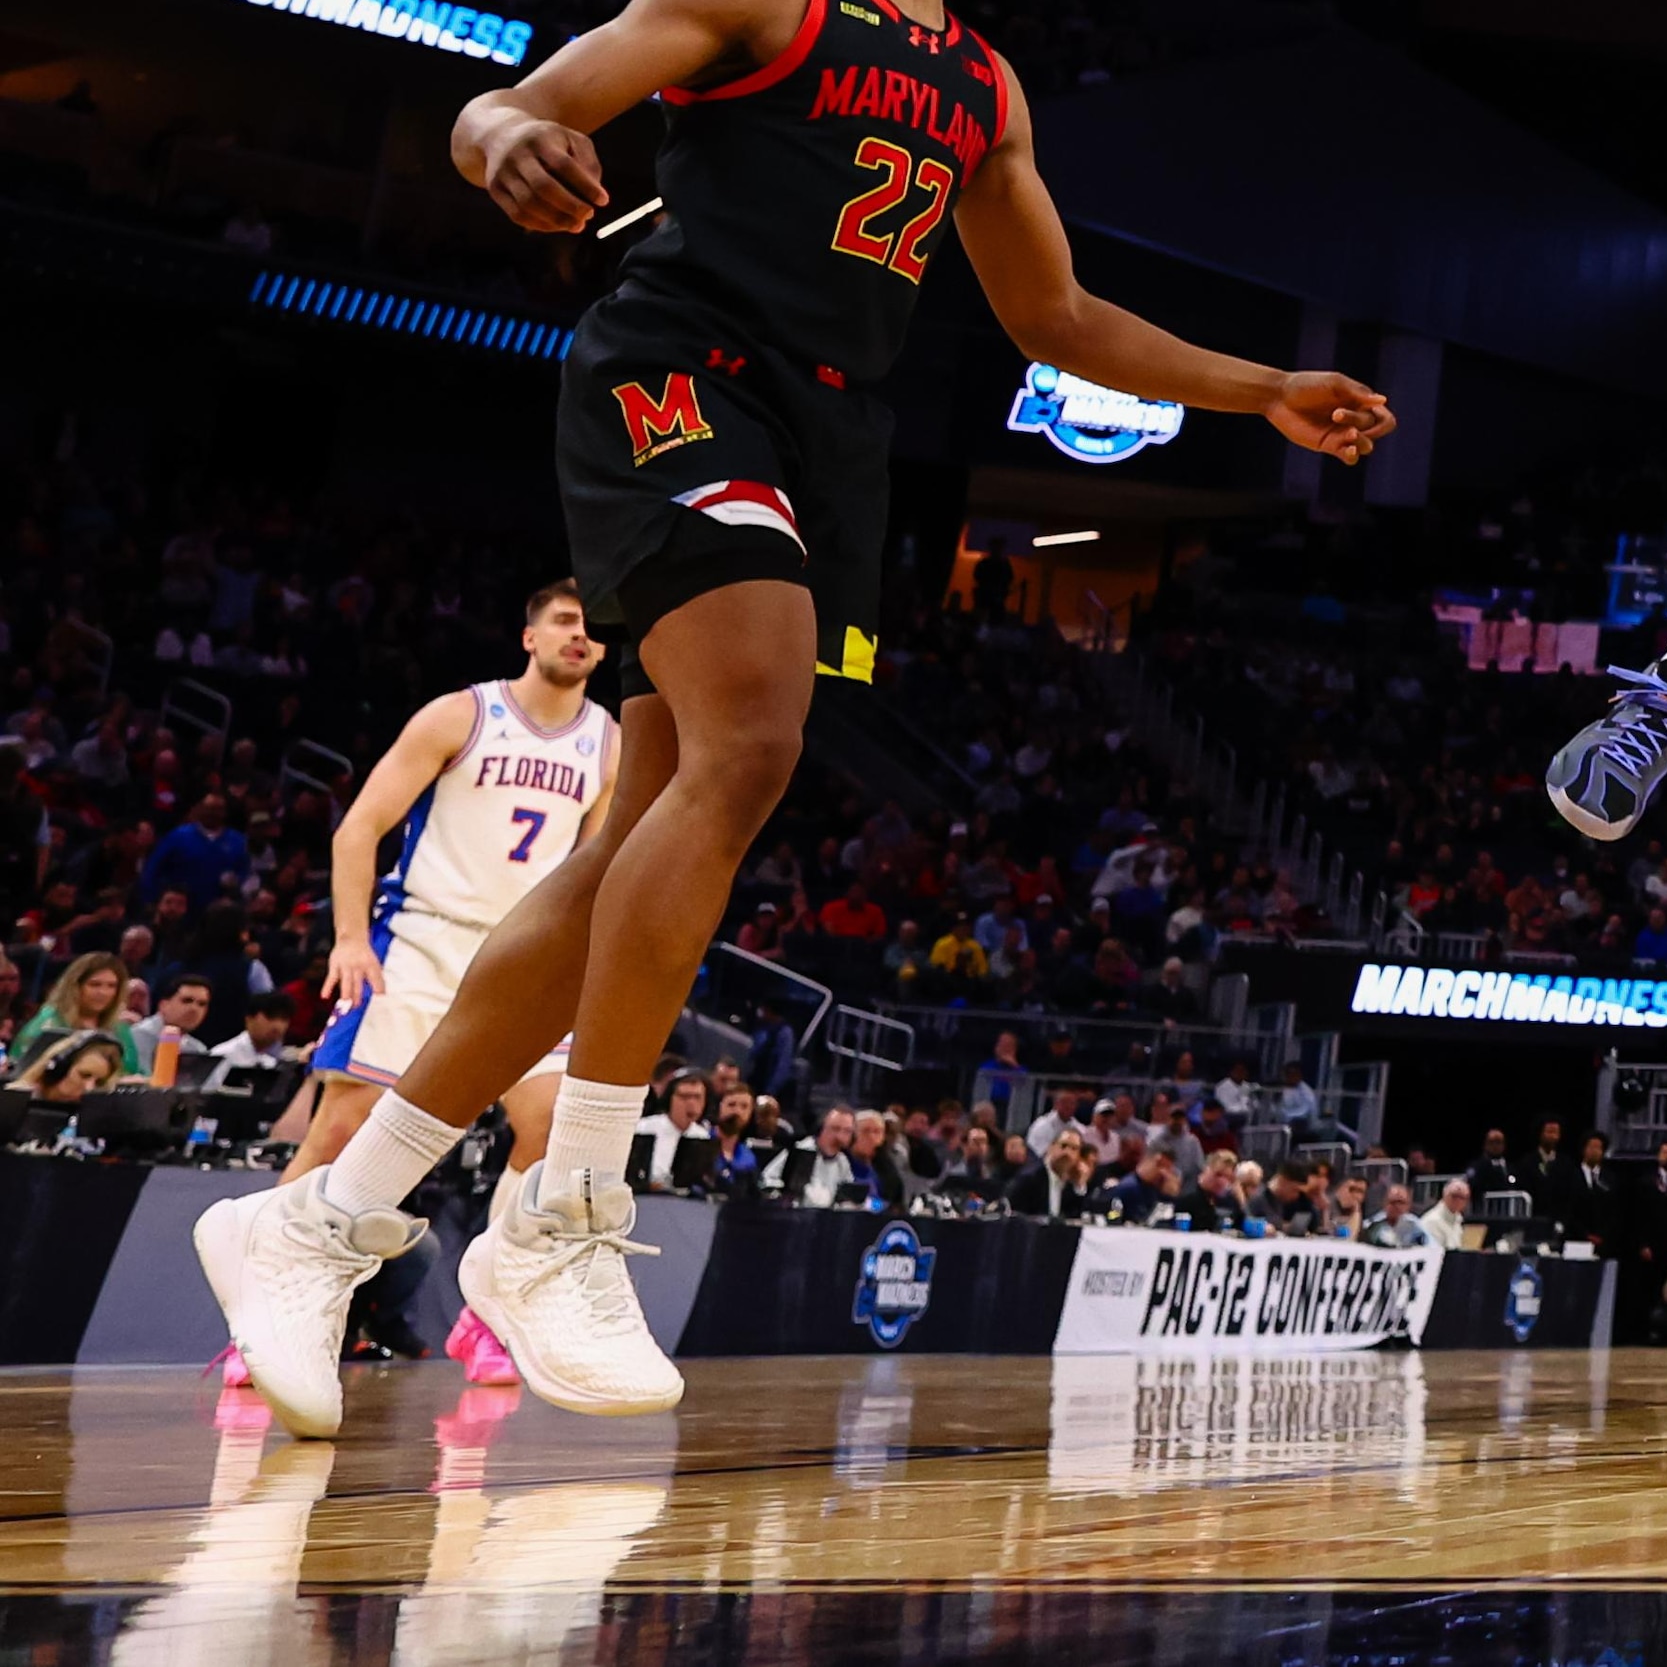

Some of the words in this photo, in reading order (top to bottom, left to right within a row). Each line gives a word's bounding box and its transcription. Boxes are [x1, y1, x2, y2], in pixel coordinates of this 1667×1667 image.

[831, 136, 953, 286] 22
[611, 372, 711, 456] M
[474, 755, 587, 804] FLORIDA
[508, 806, 548, 863] 7
[1082, 1270, 1129, 1296] HOSTED
[1129, 1271, 1145, 1297] BY
[1141, 1247, 1254, 1336] PAC-12
[1257, 1253, 1425, 1334] CONFERENCE
